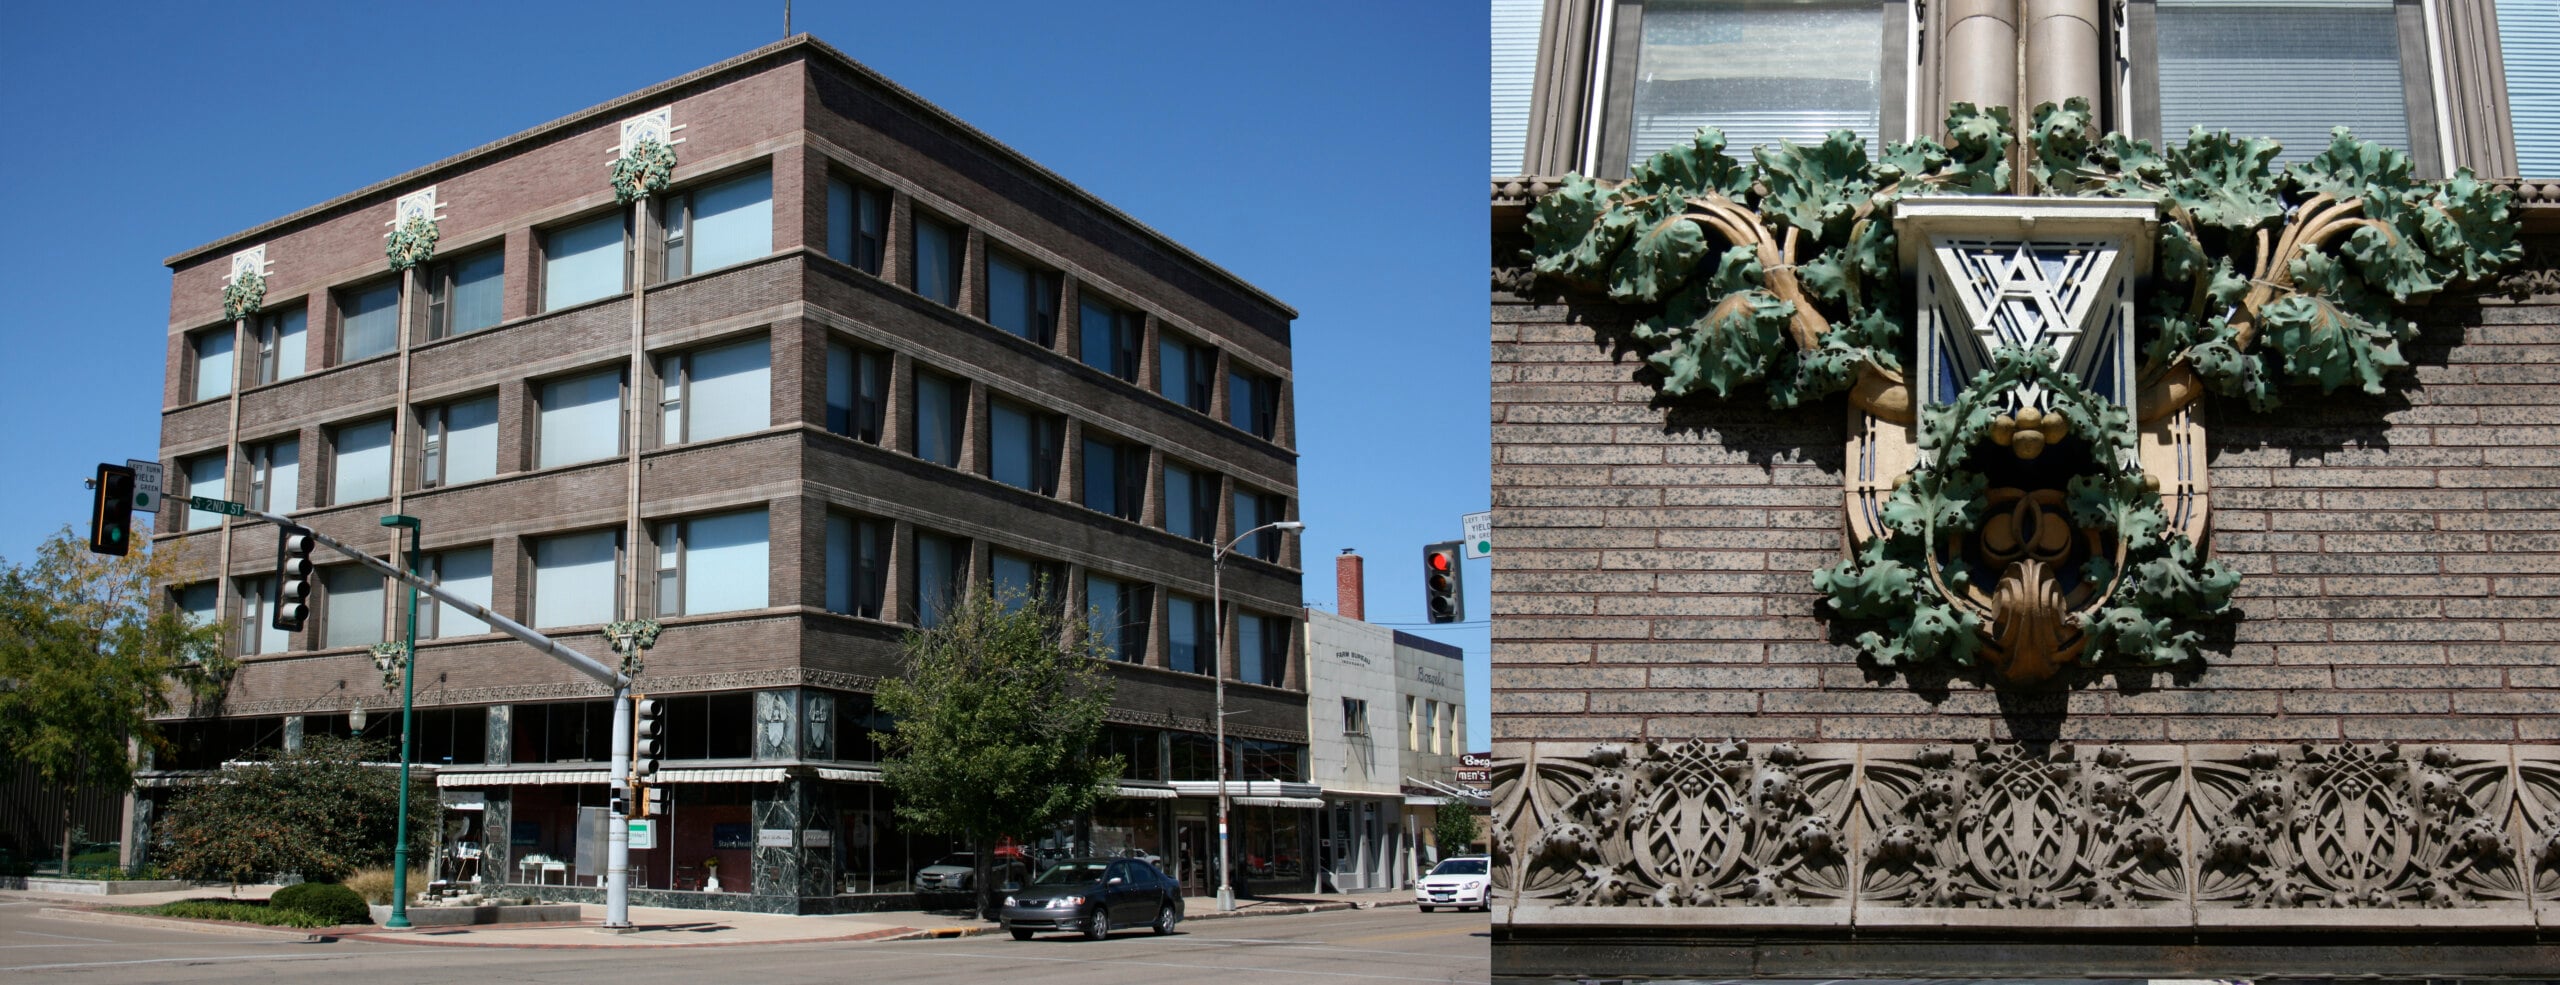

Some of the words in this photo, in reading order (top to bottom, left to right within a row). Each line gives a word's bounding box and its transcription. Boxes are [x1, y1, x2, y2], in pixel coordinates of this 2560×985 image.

[146, 465, 161, 473] TURN
[135, 473, 155, 483] YIELD
[140, 483, 159, 492] GREEN
[194, 497, 201, 509] S
[205, 499, 225, 513] 2ND
[230, 503, 243, 516] ST
[1465, 516, 1478, 524] LEFT
[1471, 522, 1491, 532] YIELD
[1351, 651, 1371, 665] BUREAU
